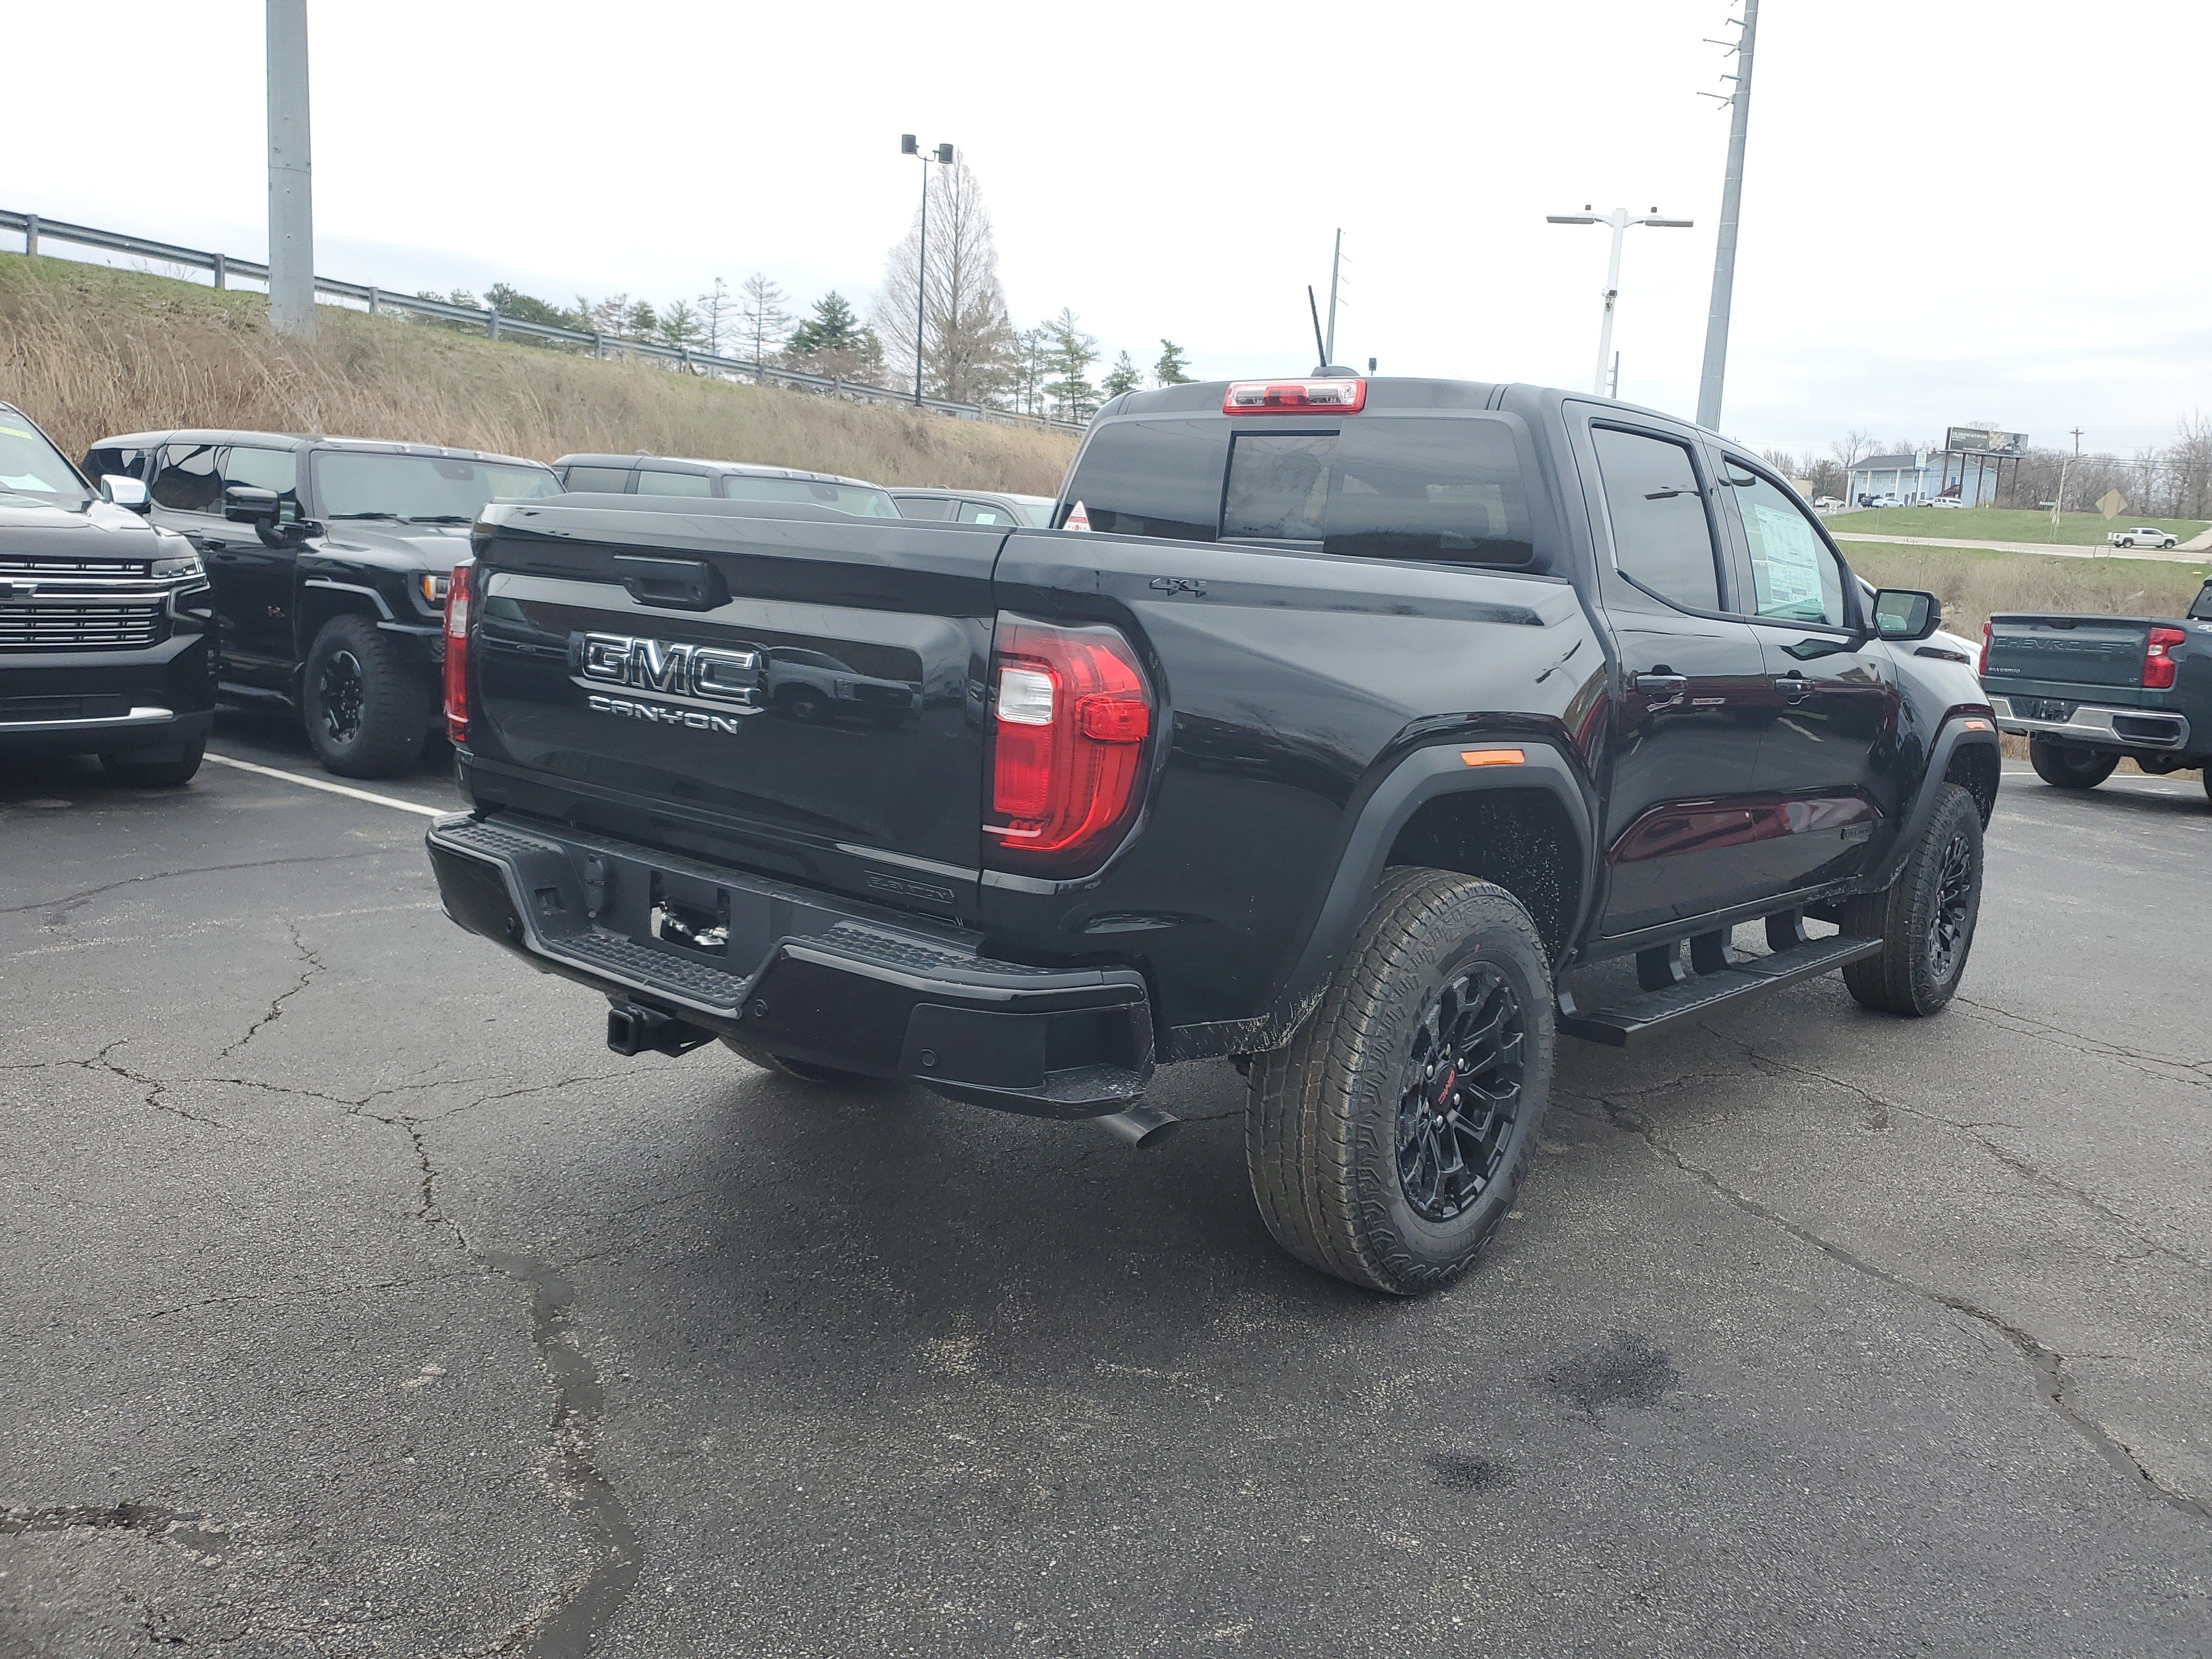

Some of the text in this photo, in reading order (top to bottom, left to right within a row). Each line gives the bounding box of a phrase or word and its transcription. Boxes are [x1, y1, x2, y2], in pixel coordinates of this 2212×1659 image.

[1995, 637, 2132, 654] CHEVROLET
[581, 632, 755, 704] GMC
[588, 695, 738, 735] CANYON
[1437, 1069, 1455, 1104] GMC
